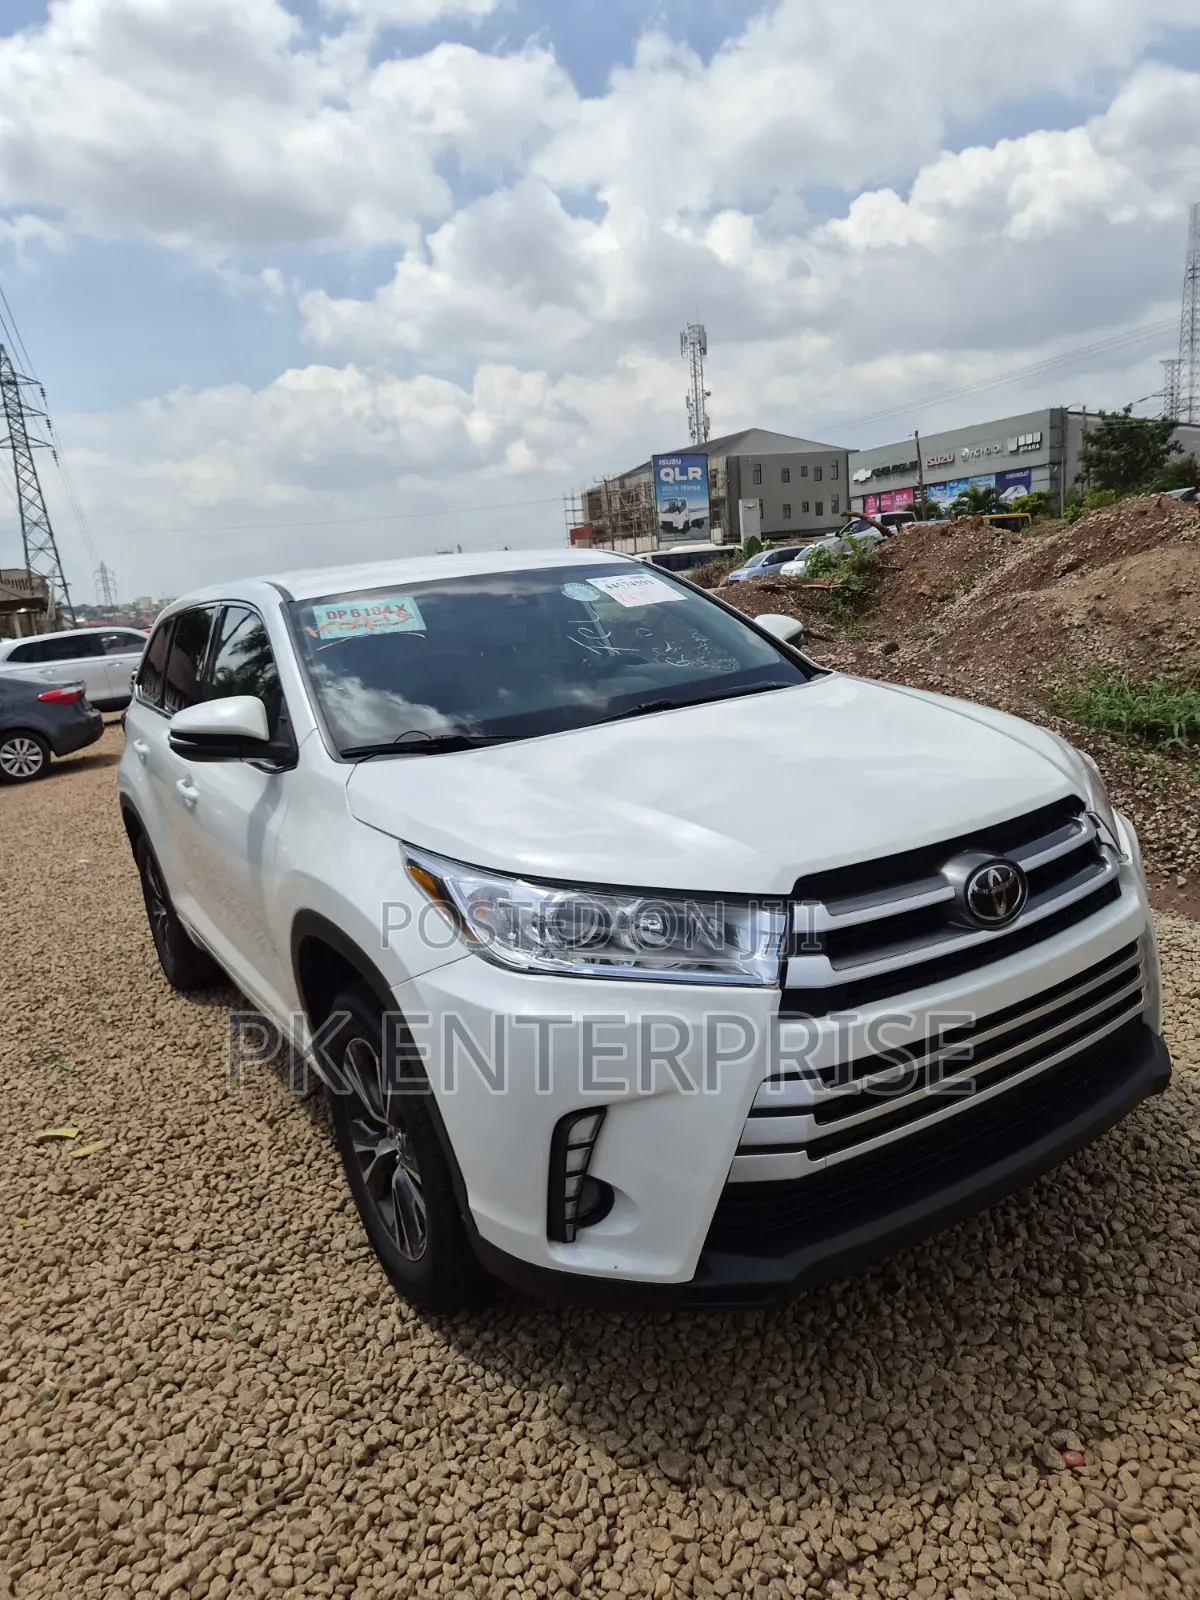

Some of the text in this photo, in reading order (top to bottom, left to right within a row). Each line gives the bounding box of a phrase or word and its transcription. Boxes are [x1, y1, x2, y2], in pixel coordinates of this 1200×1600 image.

[926, 453, 954, 468] ISUZU
[660, 466, 702, 483] QLR
[1006, 470, 1029, 479] CHEVROLET
[681, 484, 701, 492] Horse
